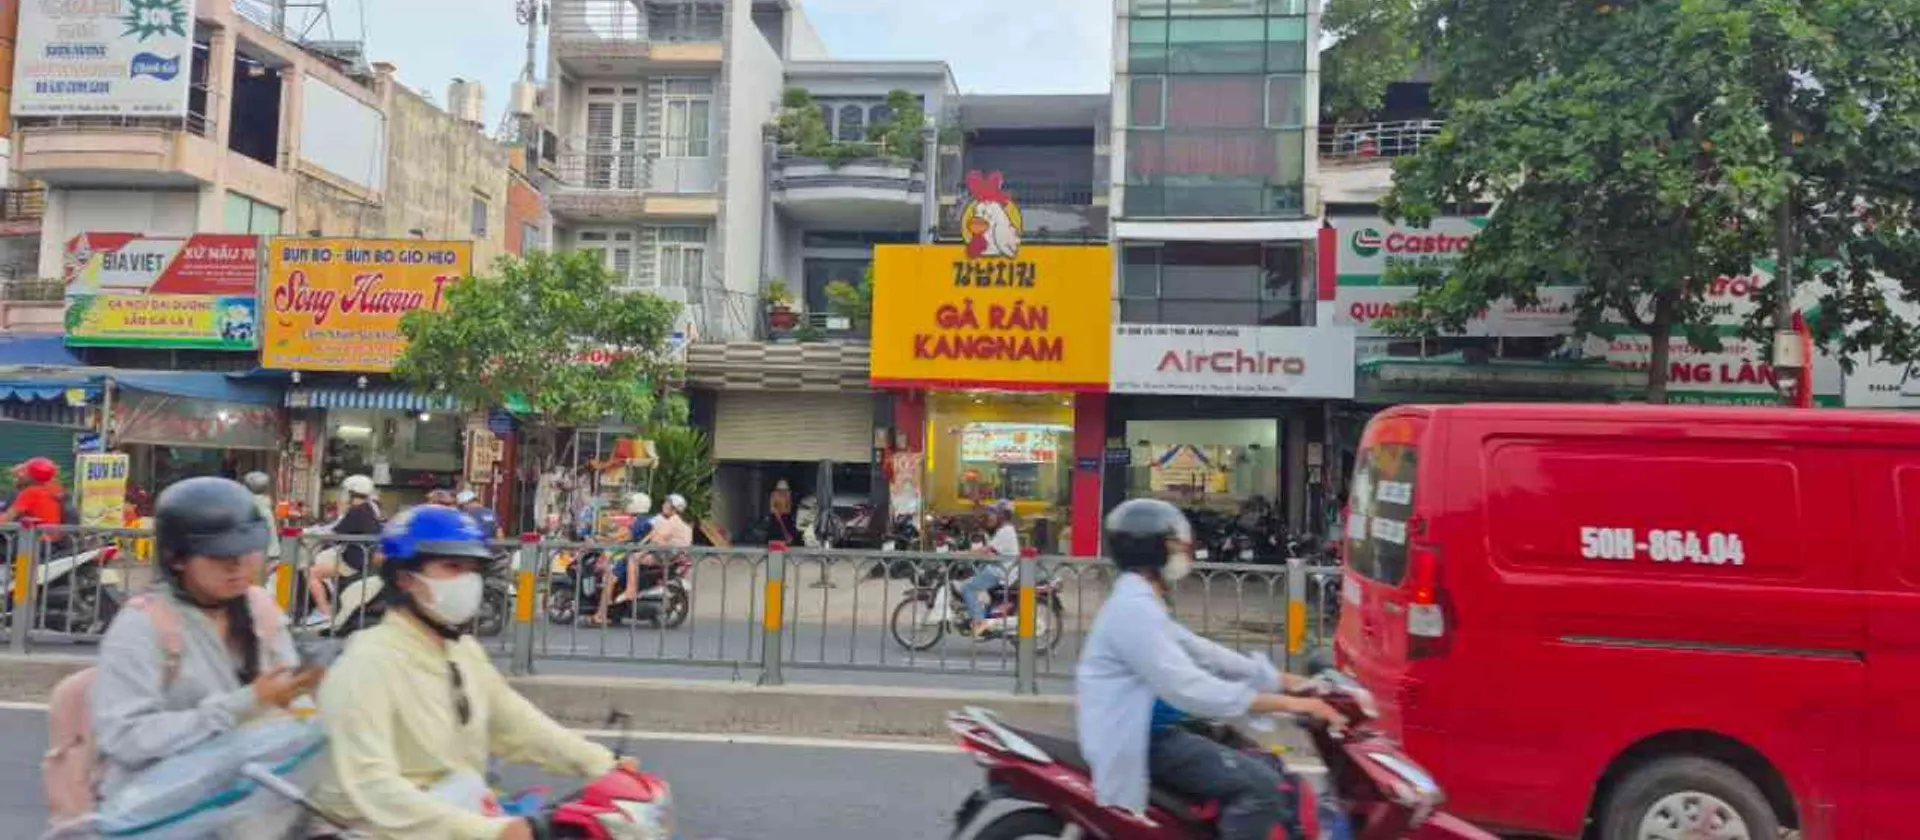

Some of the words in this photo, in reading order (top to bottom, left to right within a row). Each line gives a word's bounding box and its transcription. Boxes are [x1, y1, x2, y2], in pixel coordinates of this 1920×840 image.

[1386, 233, 1474, 253] Castro
[935, 298, 979, 330] GÀ
[988, 299, 1049, 331] RÁN
[913, 334, 1064, 362] KANGNAM
[1157, 349, 1305, 375] AirChiro
